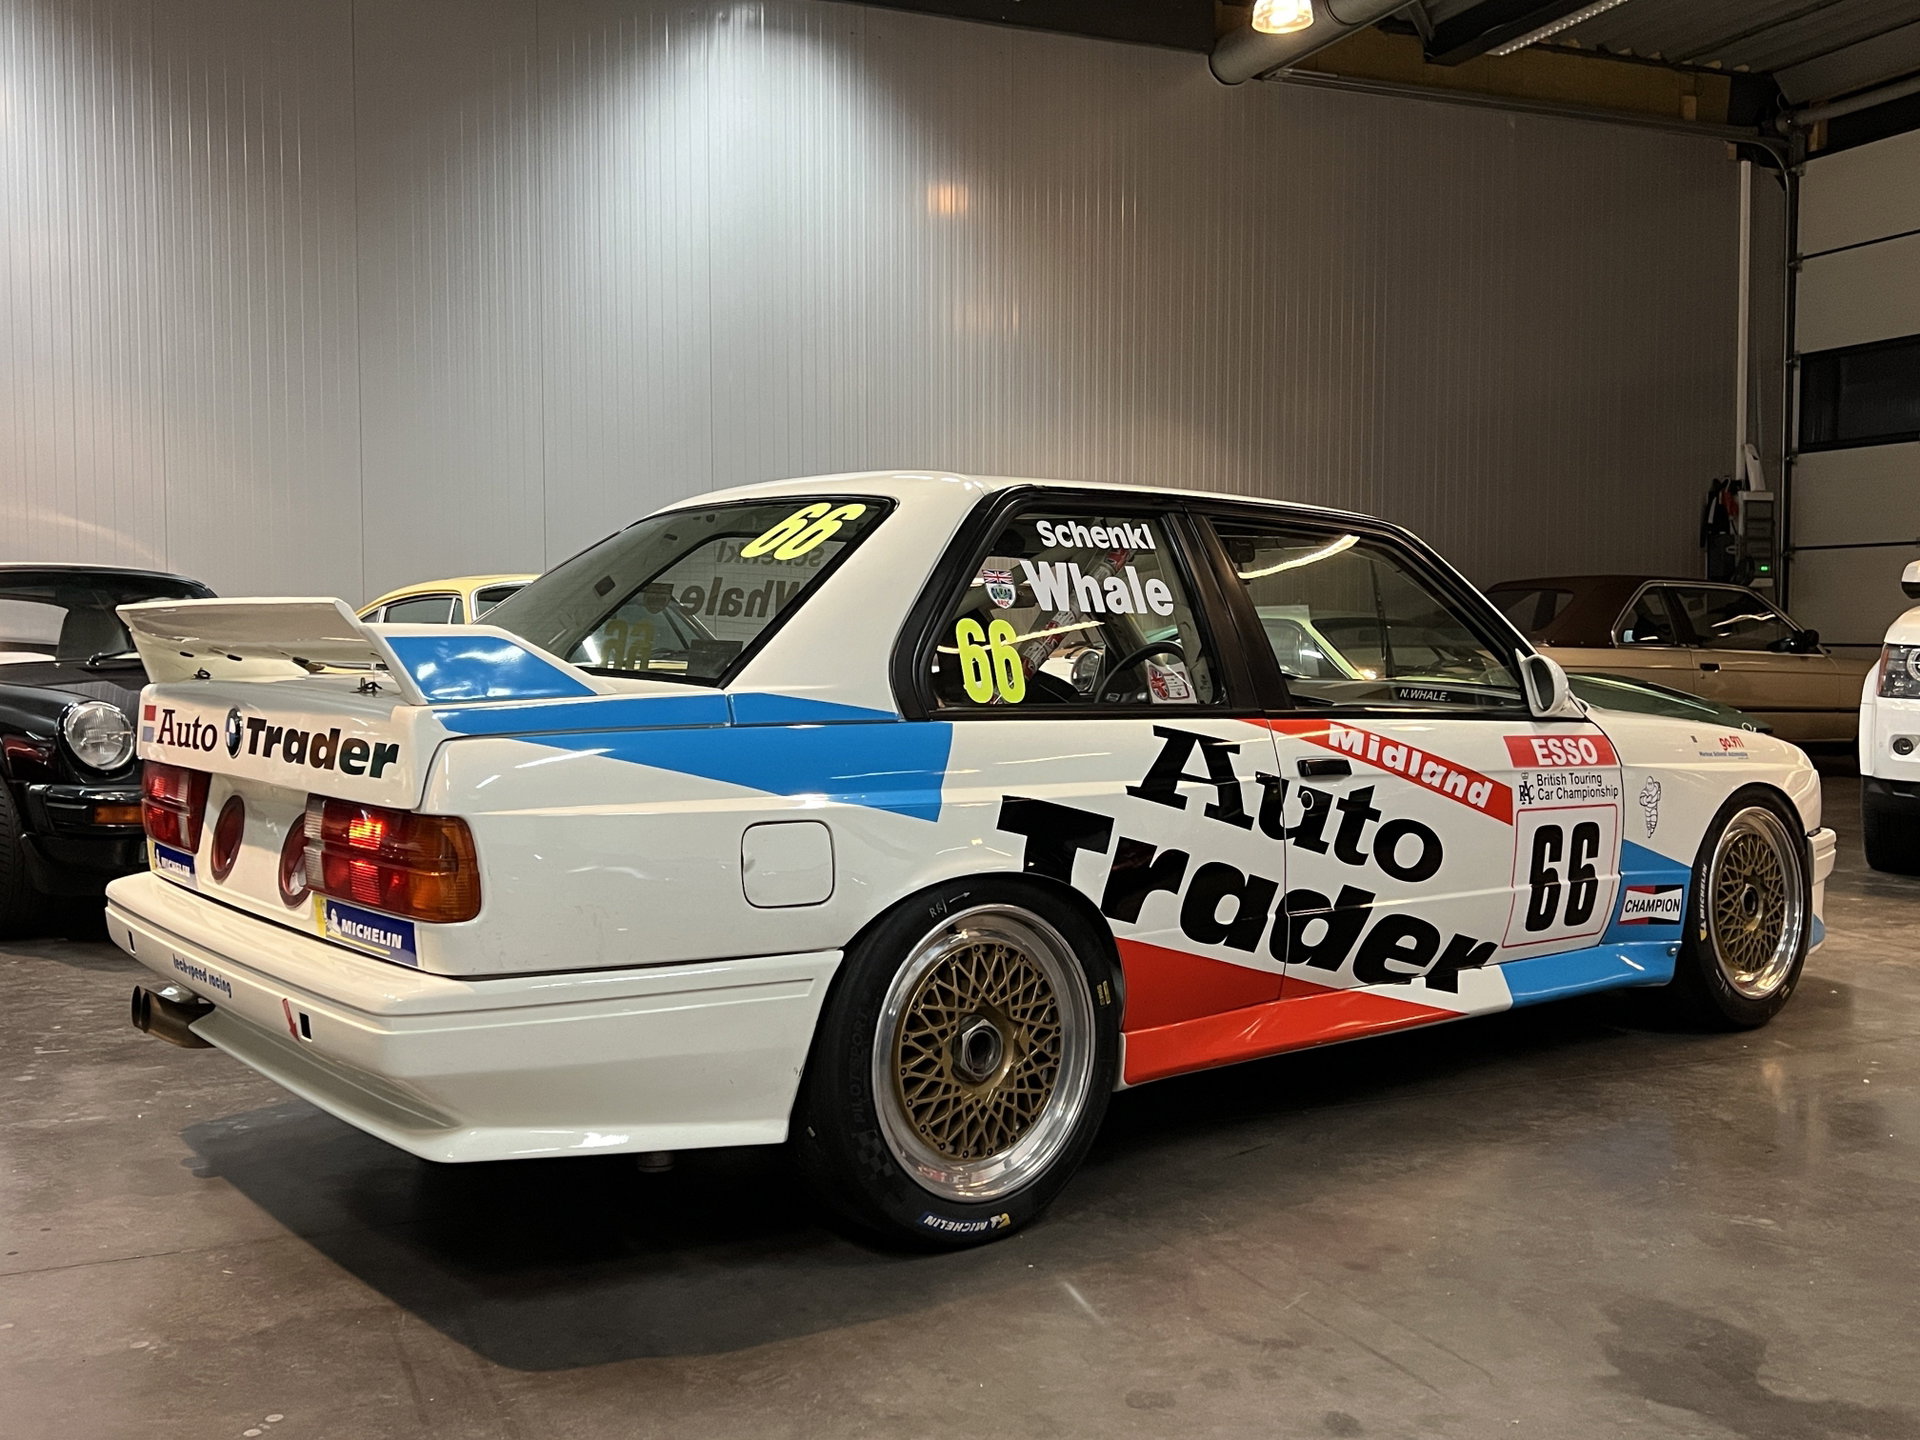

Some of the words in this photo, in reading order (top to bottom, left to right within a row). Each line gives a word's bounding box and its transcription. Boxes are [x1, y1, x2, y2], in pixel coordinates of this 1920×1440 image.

[740, 502, 866, 560] 66
[1036, 520, 1157, 550] Schenkl
[1019, 559, 1174, 616] Whale
[955, 617, 1026, 704] 66
[157, 708, 217, 752] Auto
[246, 717, 400, 779] Trader
[1328, 722, 1493, 809] Midland
[1530, 737, 1598, 766] ESSO
[1125, 725, 1443, 883] Auto
[1536, 773, 1567, 786] British
[1569, 772, 1602, 787] Touring
[1537, 787, 1554, 801] Car
[1556, 785, 1619, 801] Championship
[997, 795, 1499, 994] Trader
[1525, 821, 1600, 932] 66
[341, 918, 403, 949] MICHELIN
[1624, 898, 1681, 914] CHAMPION
[923, 1215, 989, 1232] MICHELIN
